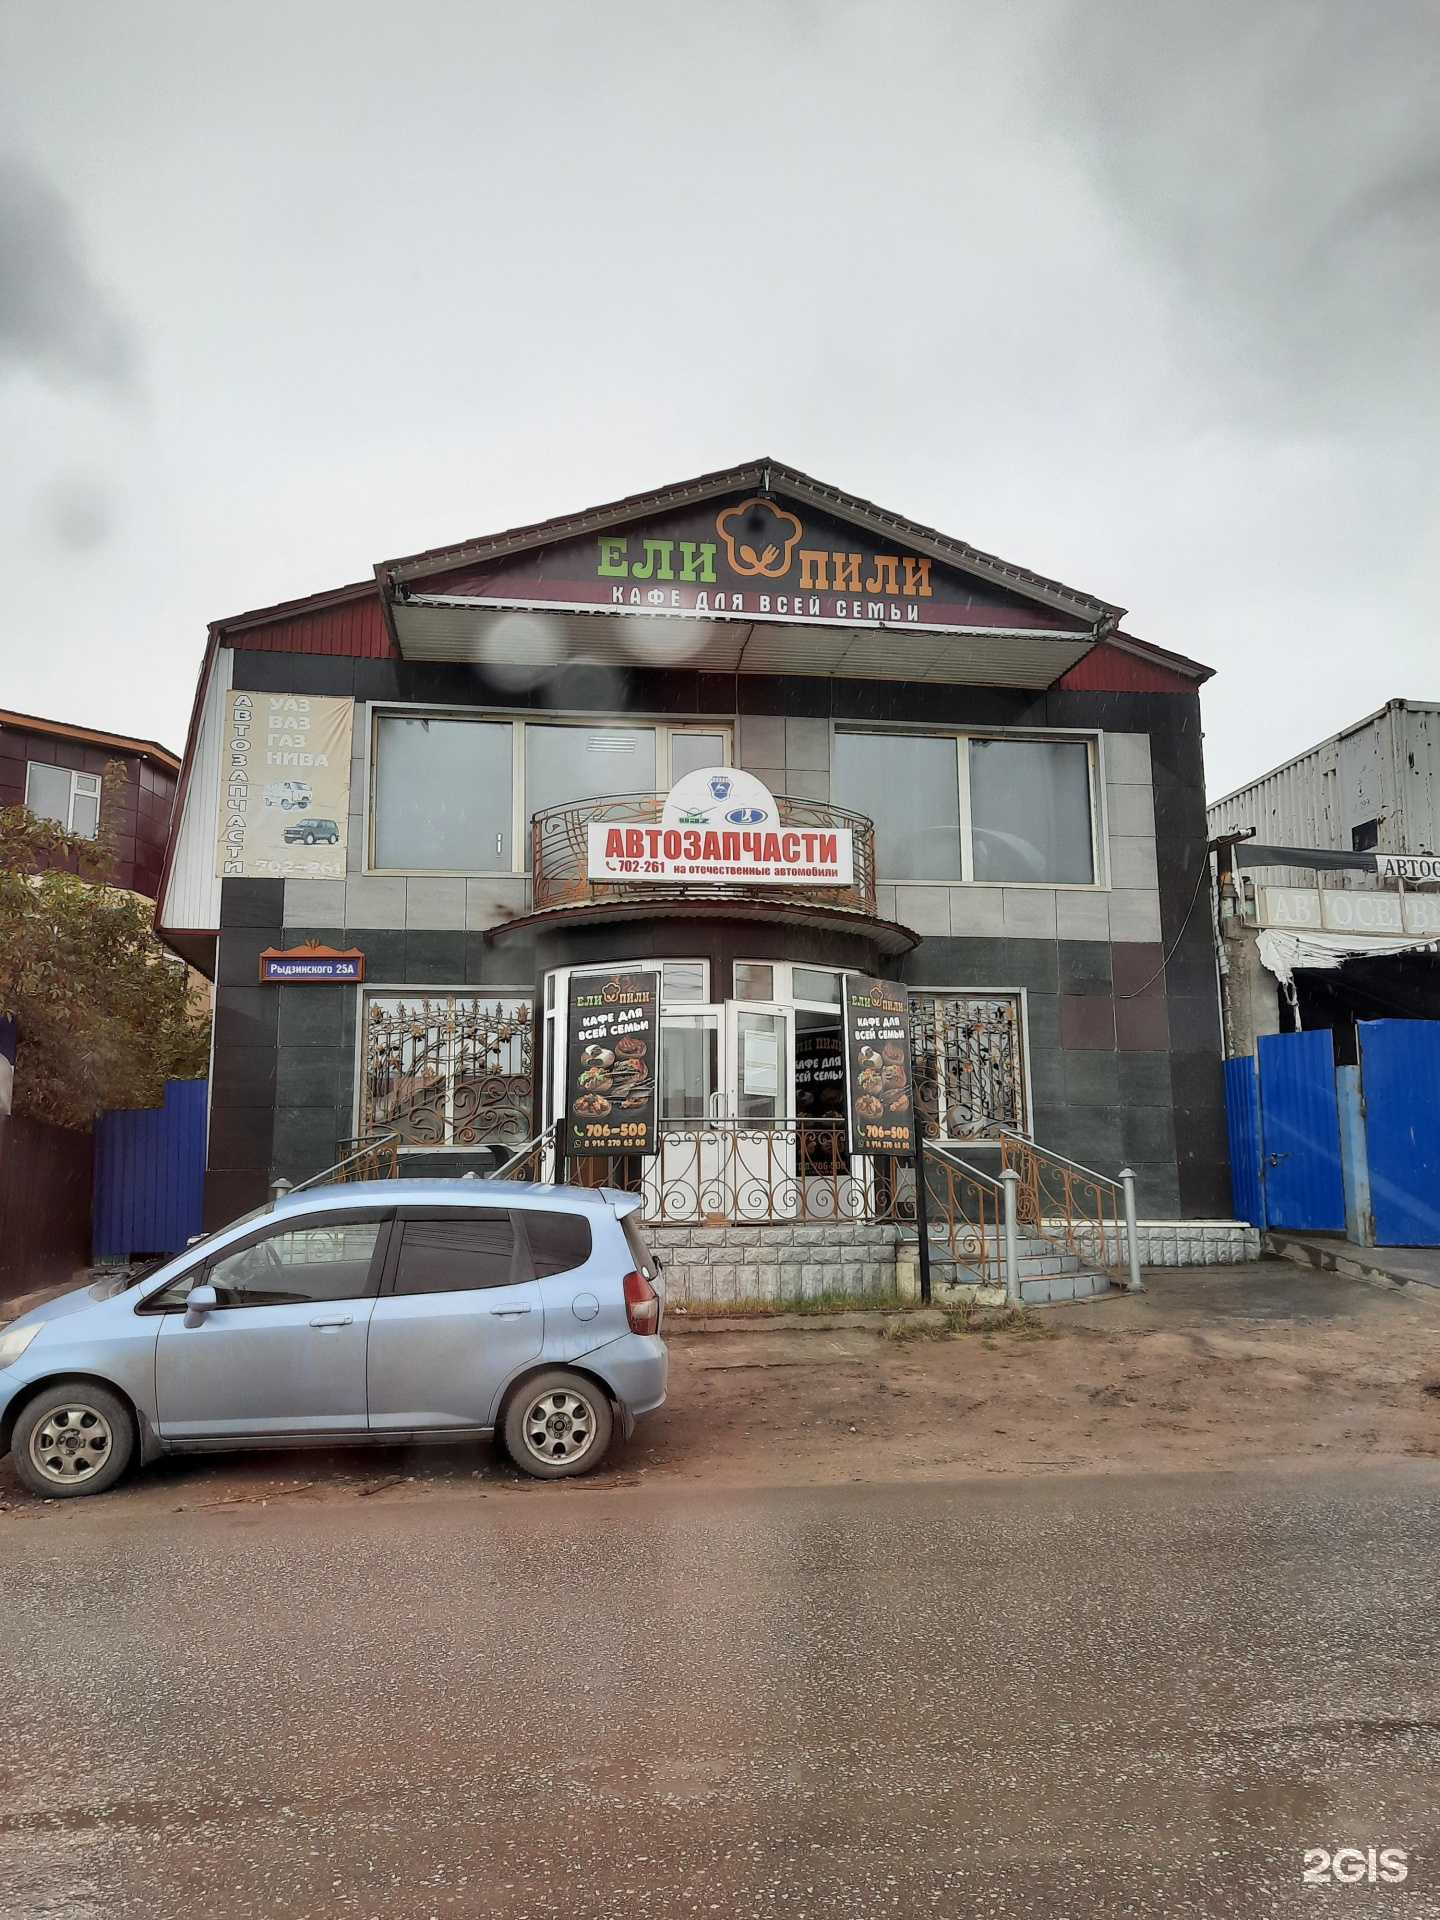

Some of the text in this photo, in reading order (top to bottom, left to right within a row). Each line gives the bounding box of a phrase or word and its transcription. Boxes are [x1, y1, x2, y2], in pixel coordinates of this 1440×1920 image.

[597, 536, 933, 597] ЕЛИ ПИЛИ
[612, 586, 919, 622] КАФЕ ДЛЯ ВСЕЙ СЕМЬИ
[269, 698, 310, 713] УАЗ
[268, 715, 310, 730] ВАЗ
[267, 733, 305, 747] ГАЗ
[266, 750, 329, 767] НИВА
[224, 694, 253, 874] АВТОЗАПЧАСТИ
[605, 828, 838, 863] АВТОЗАПЧАСТИ
[618, 860, 838, 877] 702-261 на отечественные автомобили
[1384, 859, 1440, 878] АВТОС
[270, 963, 354, 975] Рыдзинского 25А
[577, 992, 650, 1007] ЕЛИ ПИЛИ
[852, 995, 871, 1008] ЕЛИ
[582, 1008, 643, 1027] КАФЕ ДЛЯ
[857, 1017, 900, 1028] КАФЕ ДЛЯ
[578, 1020, 649, 1041] ВСЕЙ СЕМЬИ
[855, 1027, 905, 1041] ВСЕЙ СЕМЬИ
[821, 1056, 842, 1069] ДЛЯ
[795, 1071, 811, 1083] СЕЙ
[586, 1123, 647, 1137] 706-500
[866, 1125, 910, 1140] 706-500
[584, 1140, 590, 1148] 8
[607, 1139, 621, 1147] 270
[623, 1139, 633, 1147] 65
[635, 1138, 646, 1146] 00
